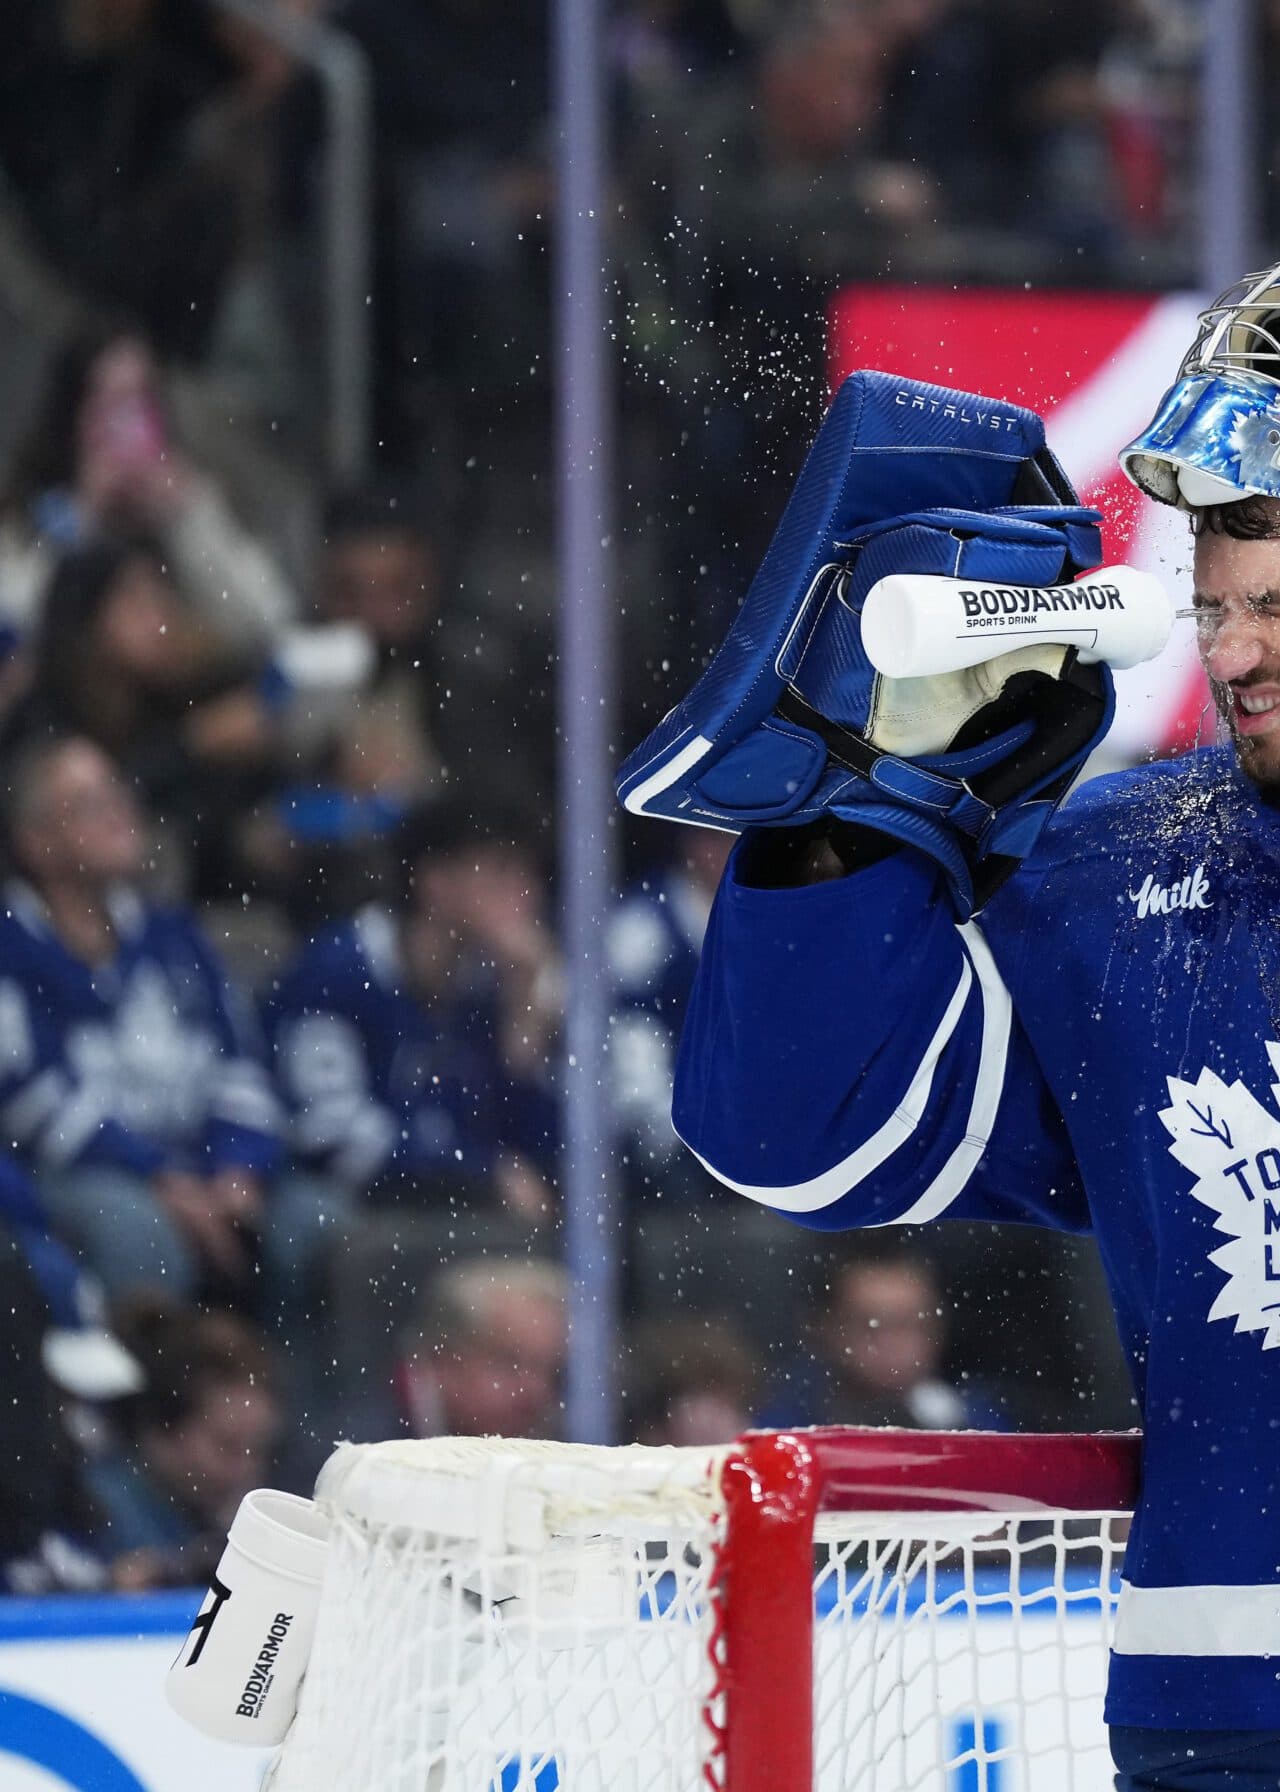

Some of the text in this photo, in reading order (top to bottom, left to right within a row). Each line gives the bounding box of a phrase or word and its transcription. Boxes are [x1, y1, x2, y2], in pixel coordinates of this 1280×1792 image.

[895, 391, 1017, 431] CATALYST
[958, 584, 1125, 617] BODYARMOR
[966, 615, 1038, 628] SPORTS DRINK
[235, 1612, 294, 1717] BODYARMOR
